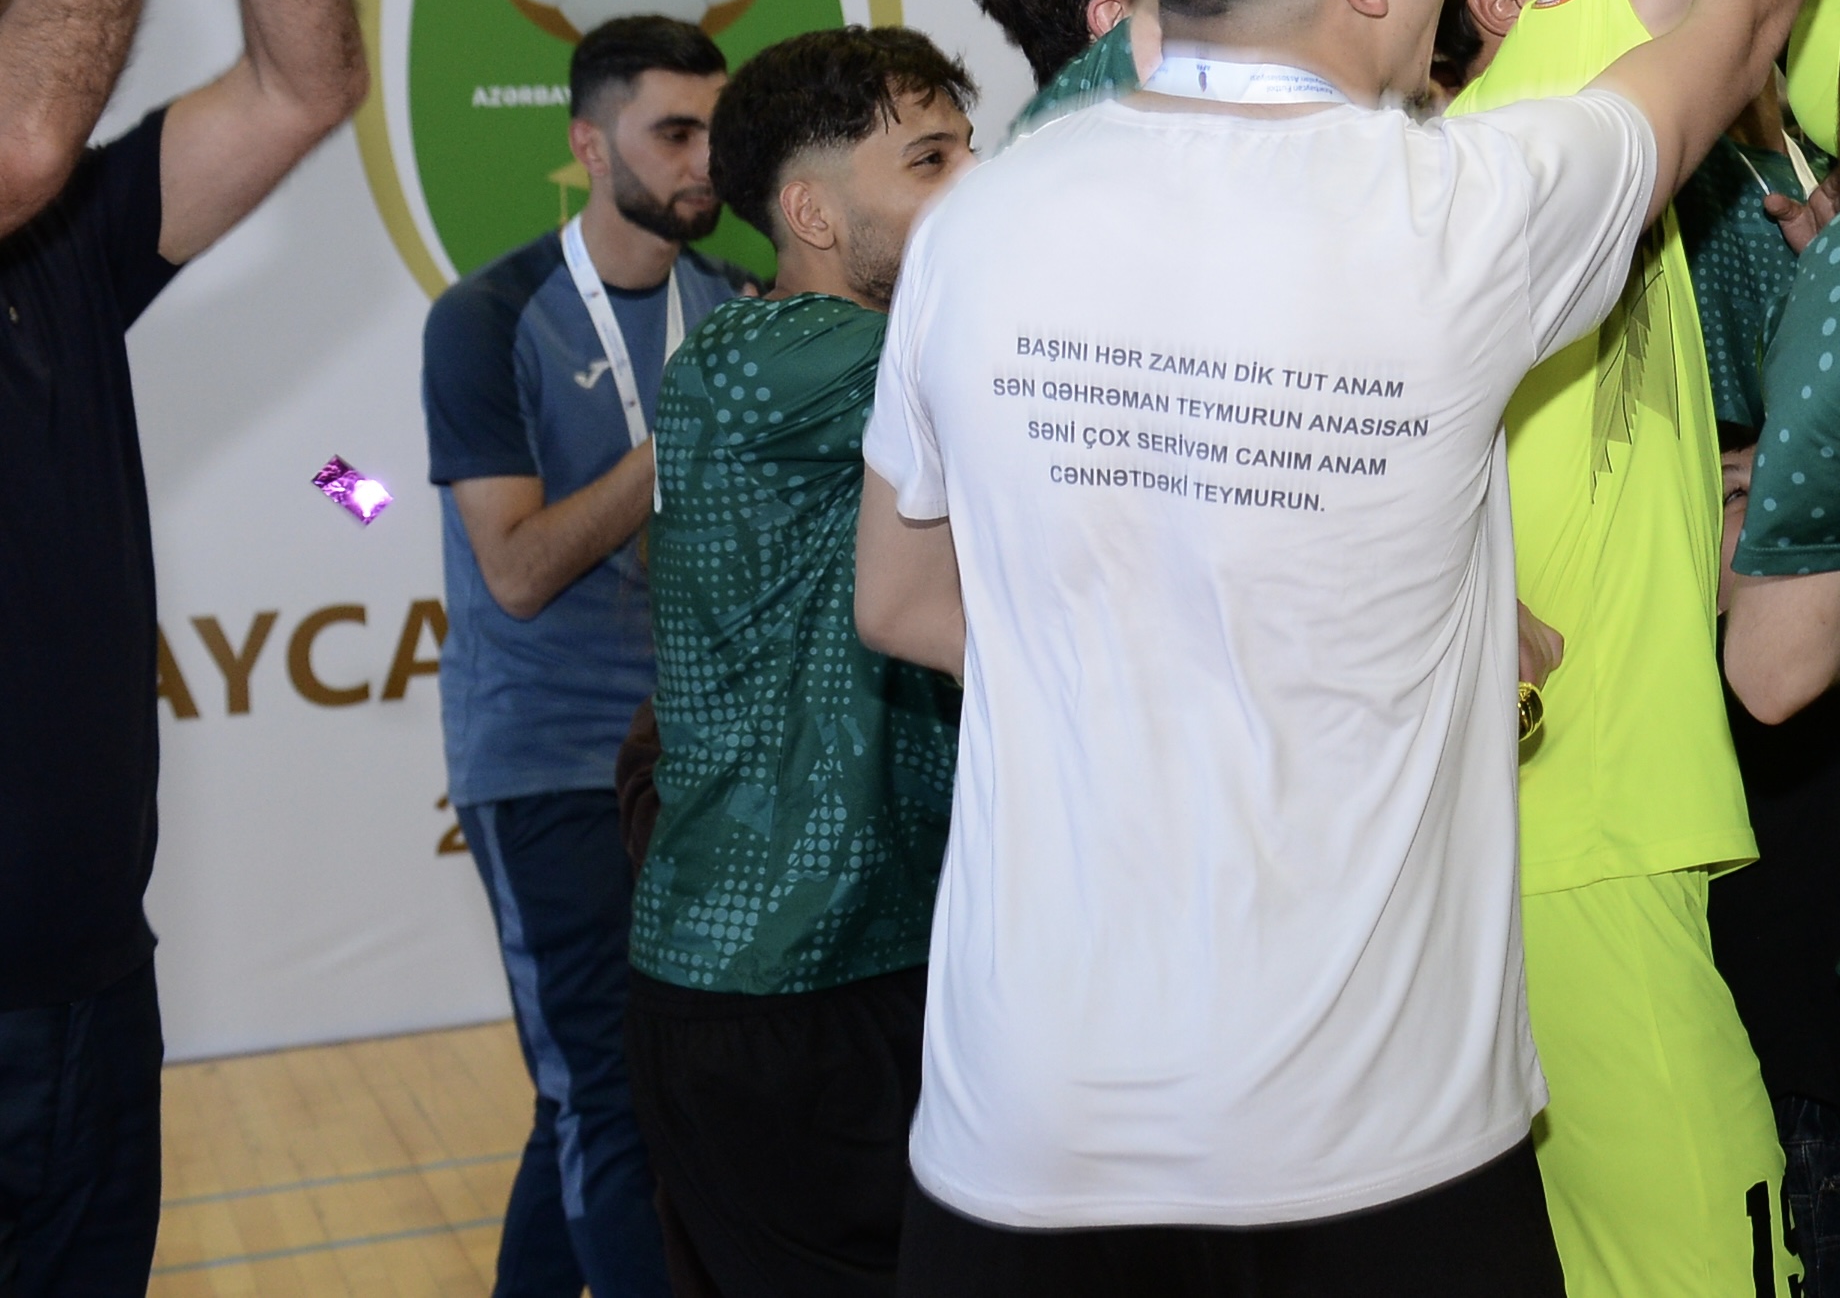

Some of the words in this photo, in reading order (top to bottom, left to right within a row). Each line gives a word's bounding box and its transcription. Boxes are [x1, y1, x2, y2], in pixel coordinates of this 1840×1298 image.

[1016, 336, 1088, 362] BAŞINI
[1095, 345, 1143, 369] HƏR
[1149, 353, 1227, 380] ZAMAN
[1234, 361, 1275, 385] DİK
[1282, 369, 1328, 391] TUT
[1332, 376, 1404, 398] ANAM
[993, 378, 1035, 397] SƏN
[1042, 381, 1169, 413] QƏHRƏMAN
[1176, 397, 1302, 430] TEYMURUN
[1308, 414, 1429, 437] ANASISAN
[1028, 420, 1075, 443] SƏNİ
[1082, 427, 1130, 449] ÇOX
[1137, 432, 1228, 464] SERİVƏM
[1236, 447, 1312, 471] CANIM
[1317, 455, 1387, 476] ANAM
[1050, 465, 1188, 497] CƏNNƏTDƏKİ
[1193, 481, 1325, 512] TEYMURUN.
